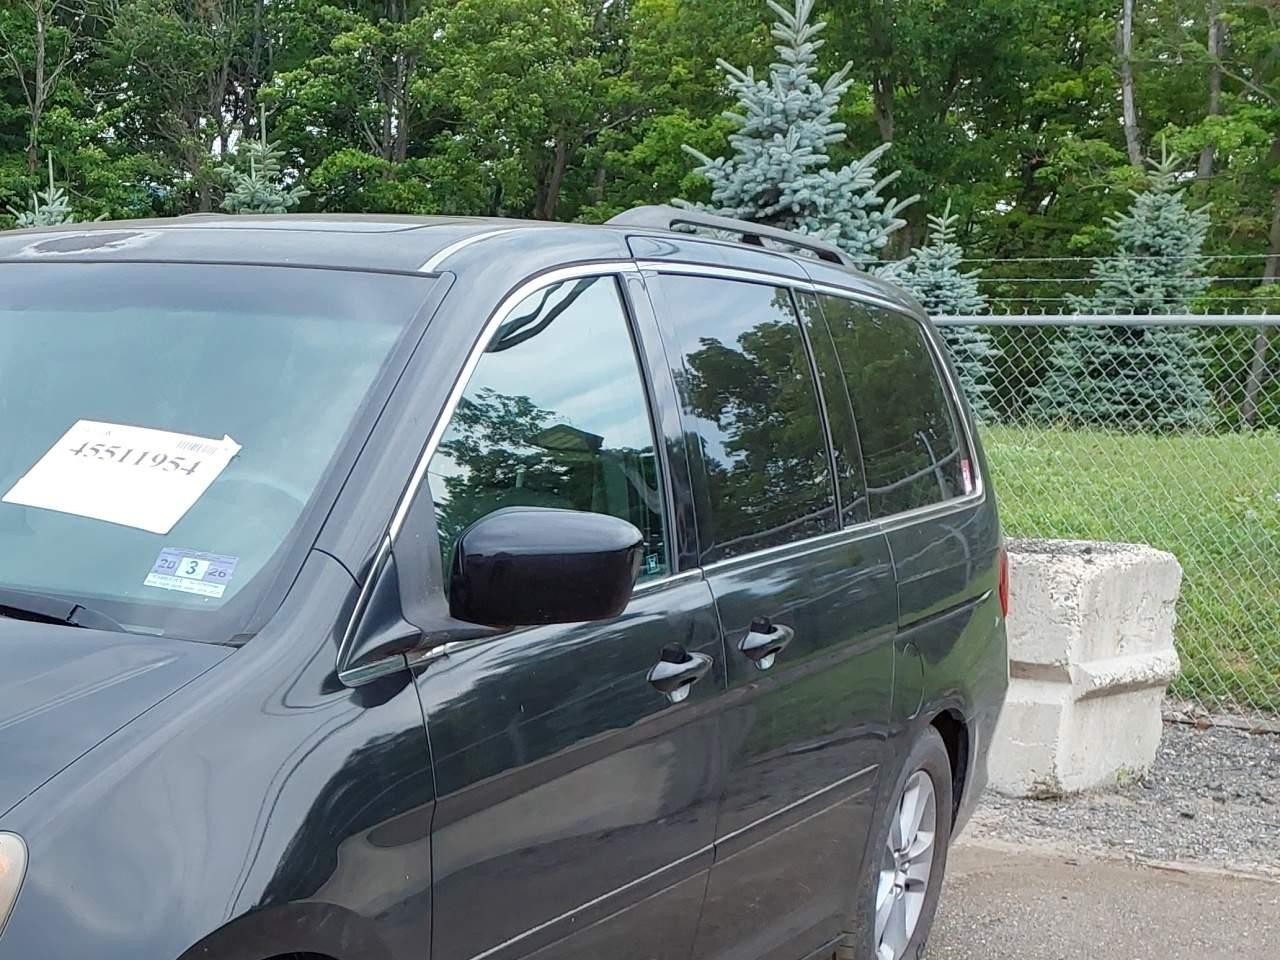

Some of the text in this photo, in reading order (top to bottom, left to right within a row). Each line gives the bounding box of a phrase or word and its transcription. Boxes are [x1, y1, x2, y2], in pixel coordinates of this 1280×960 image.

[69, 442, 200, 475] 45511954
[157, 558, 227, 578] 20 3 26
